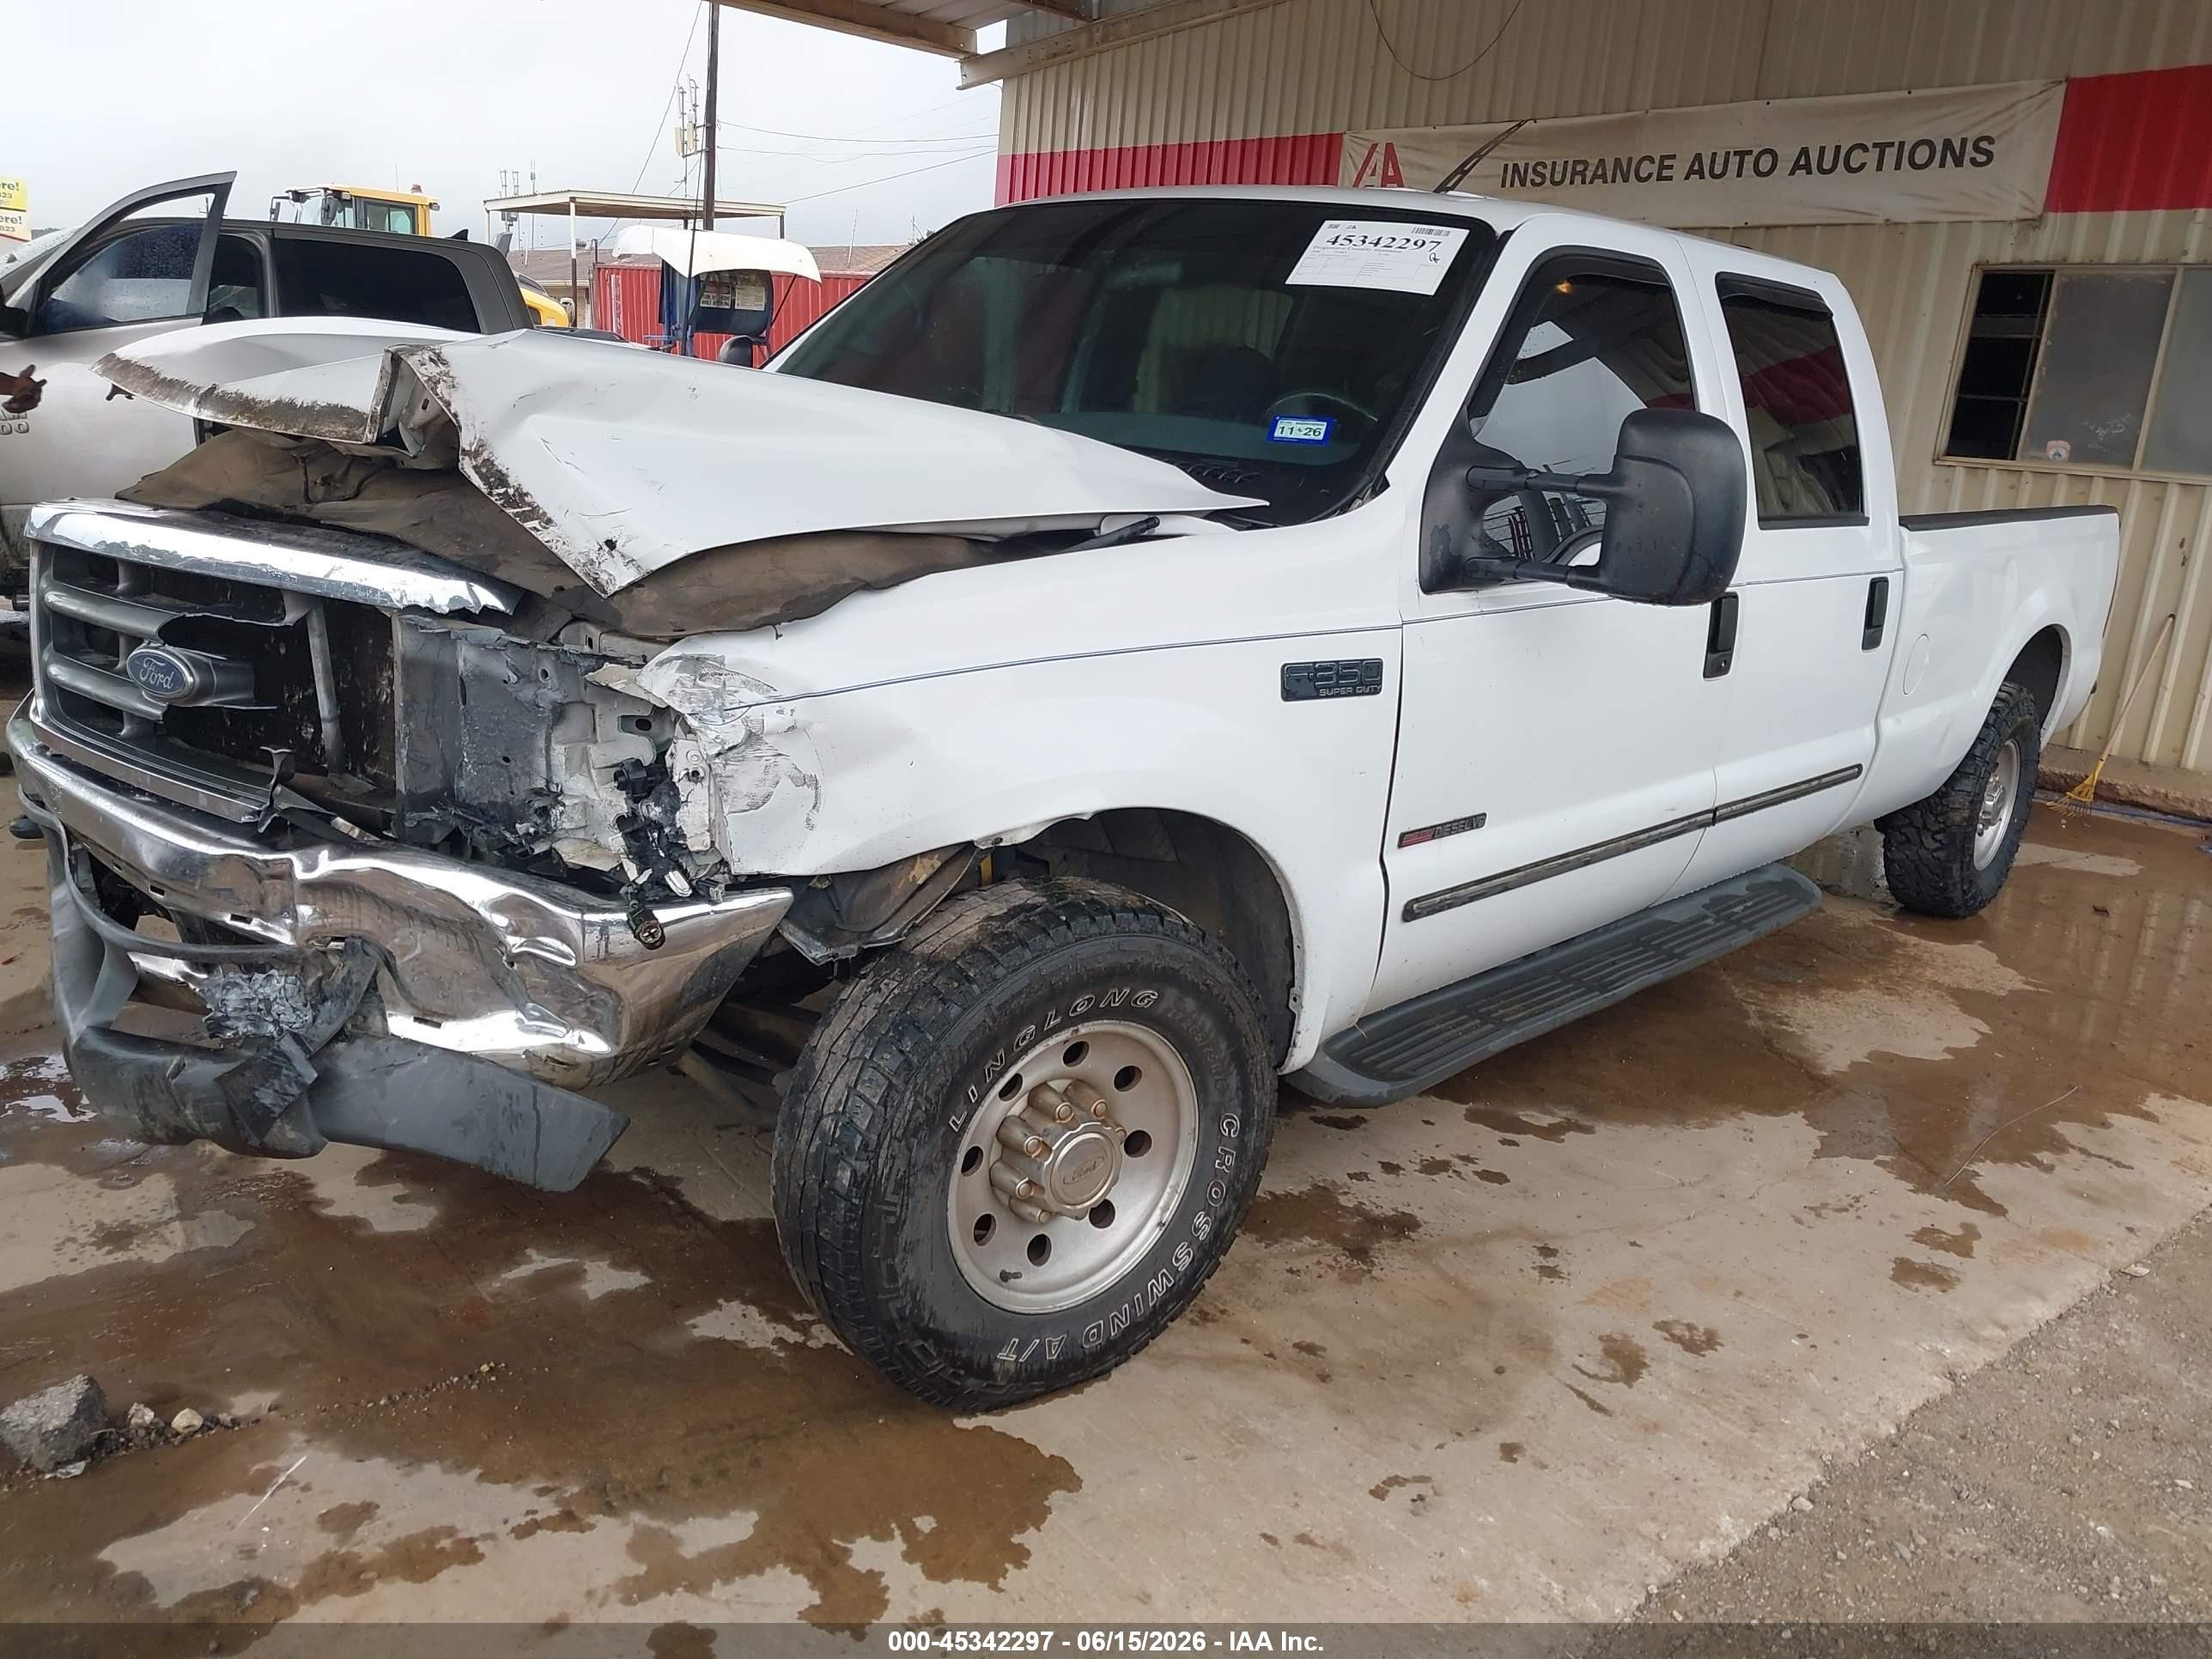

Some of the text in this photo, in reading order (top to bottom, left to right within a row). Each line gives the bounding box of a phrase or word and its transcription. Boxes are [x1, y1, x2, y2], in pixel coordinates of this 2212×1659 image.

[1500, 153, 1677, 188] INSURANCE
[1684, 148, 1779, 181] AUTO
[1788, 135, 1996, 177] AUCTIONS
[1326, 234, 1443, 252] 45342297
[139, 657, 176, 690] Ford
[1319, 684, 1382, 697] SUPER DUTY
[948, 987, 1158, 1133] LINGLONG
[996, 1112, 1240, 1364] CROSSWIND A/T
